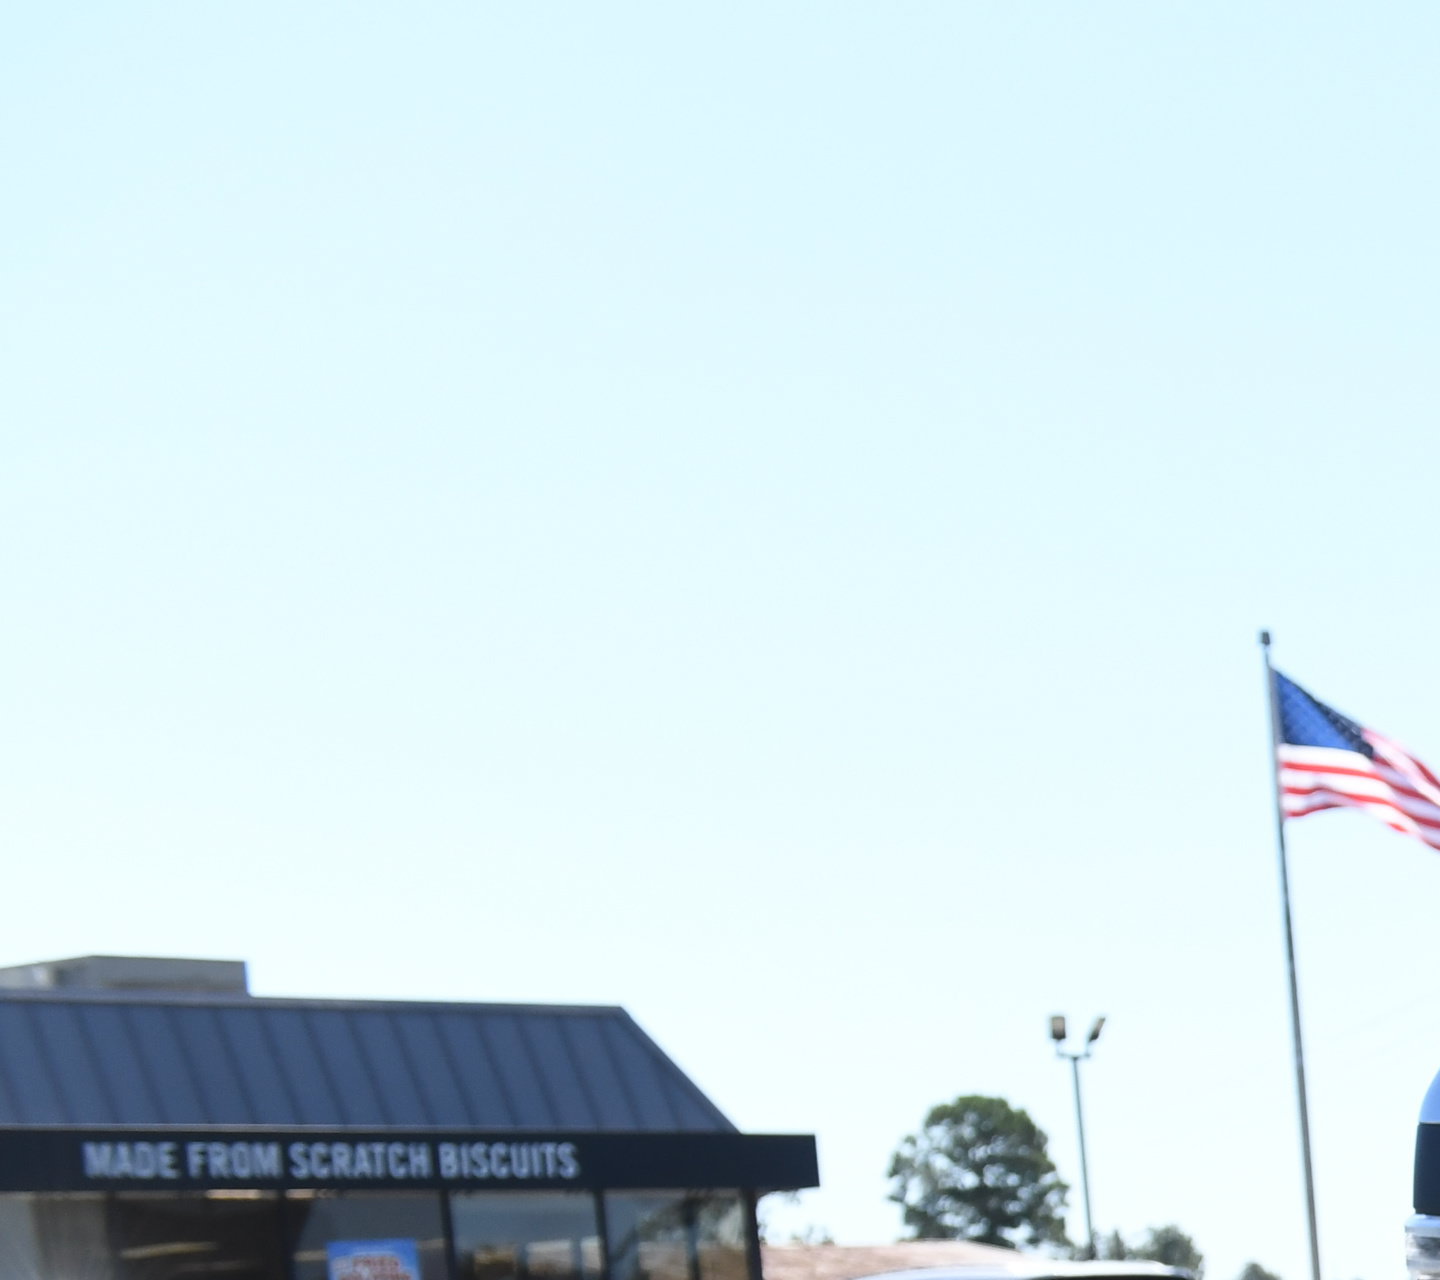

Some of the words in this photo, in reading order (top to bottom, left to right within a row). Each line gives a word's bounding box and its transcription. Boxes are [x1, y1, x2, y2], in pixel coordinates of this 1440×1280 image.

[83, 1140, 181, 1180] MADE
[186, 1140, 284, 1180] FROM
[288, 1140, 432, 1180] SCRATCH
[437, 1140, 581, 1180] BISCUITS
